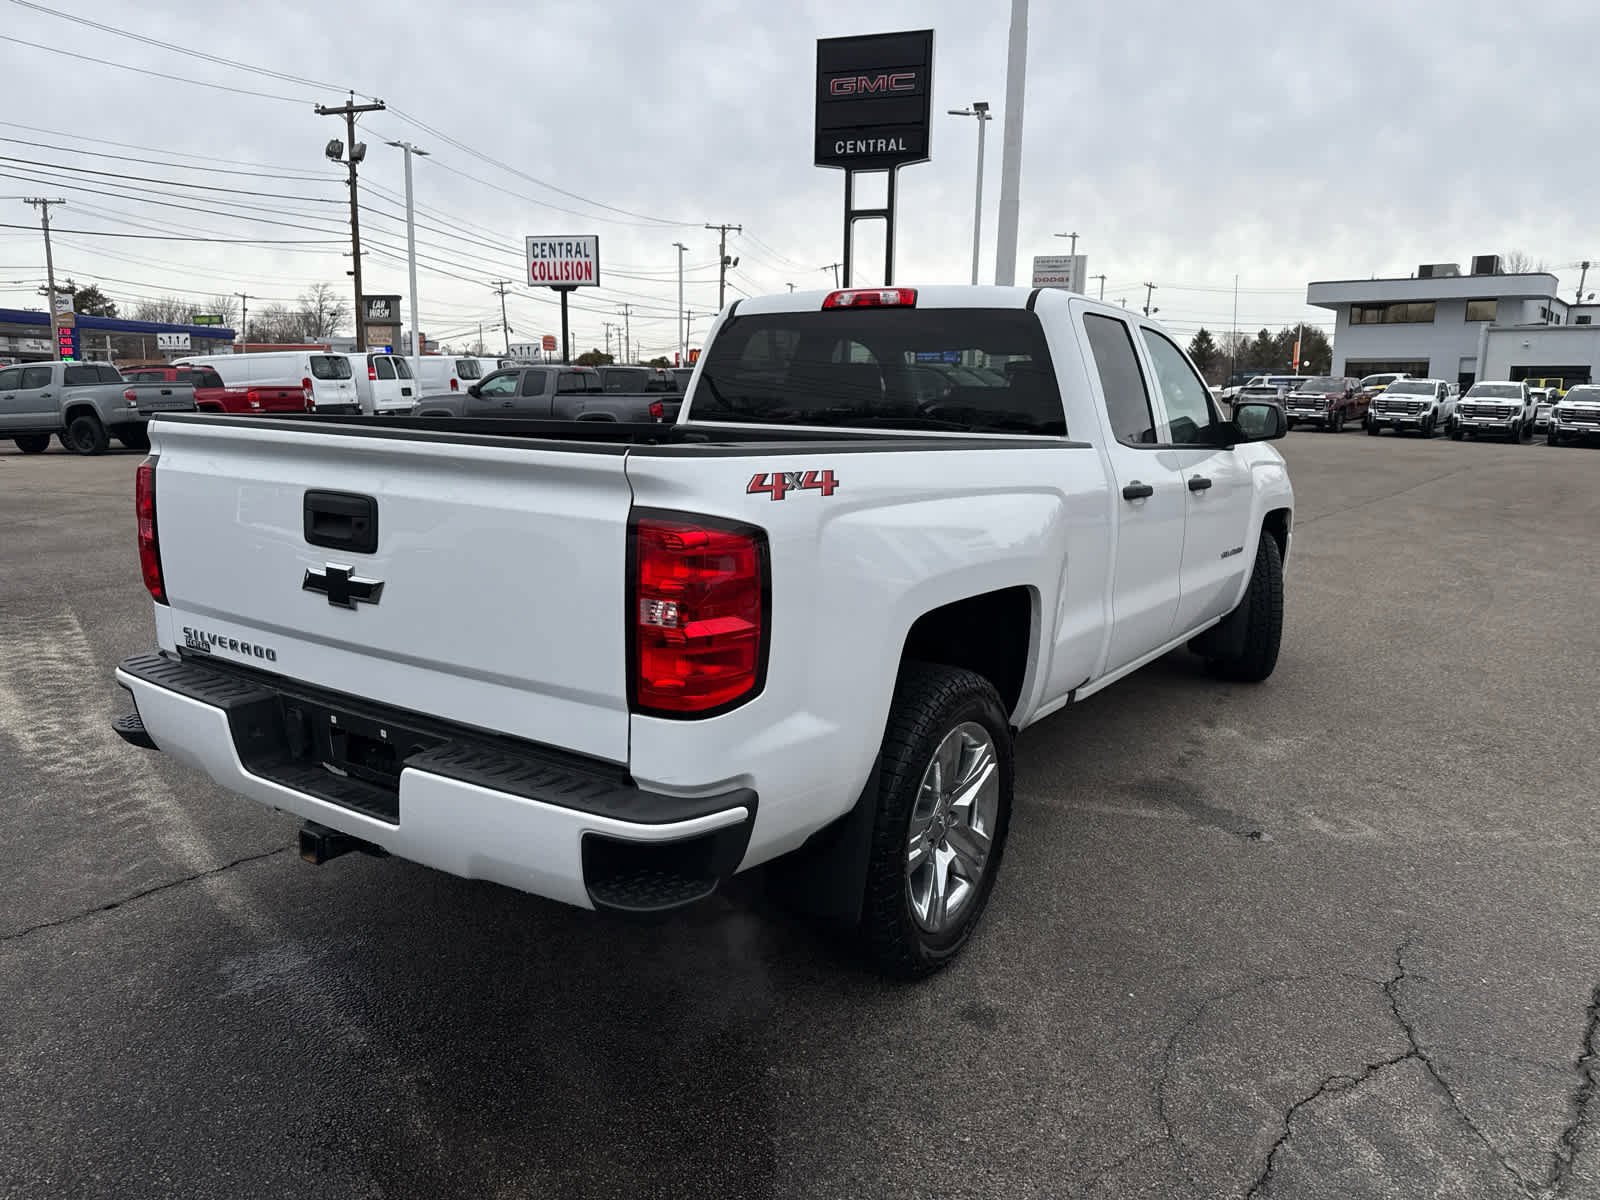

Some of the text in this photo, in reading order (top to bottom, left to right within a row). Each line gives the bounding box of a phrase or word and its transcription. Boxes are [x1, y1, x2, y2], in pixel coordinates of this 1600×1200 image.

[830, 73, 915, 95] GMC
[835, 138, 907, 154] CENTRAL
[532, 242, 590, 258] CENTRAL
[531, 261, 592, 281] COLLISION
[372, 299, 386, 309] CAR
[369, 309, 390, 318] WASH
[183, 627, 278, 662] SILVERADO
